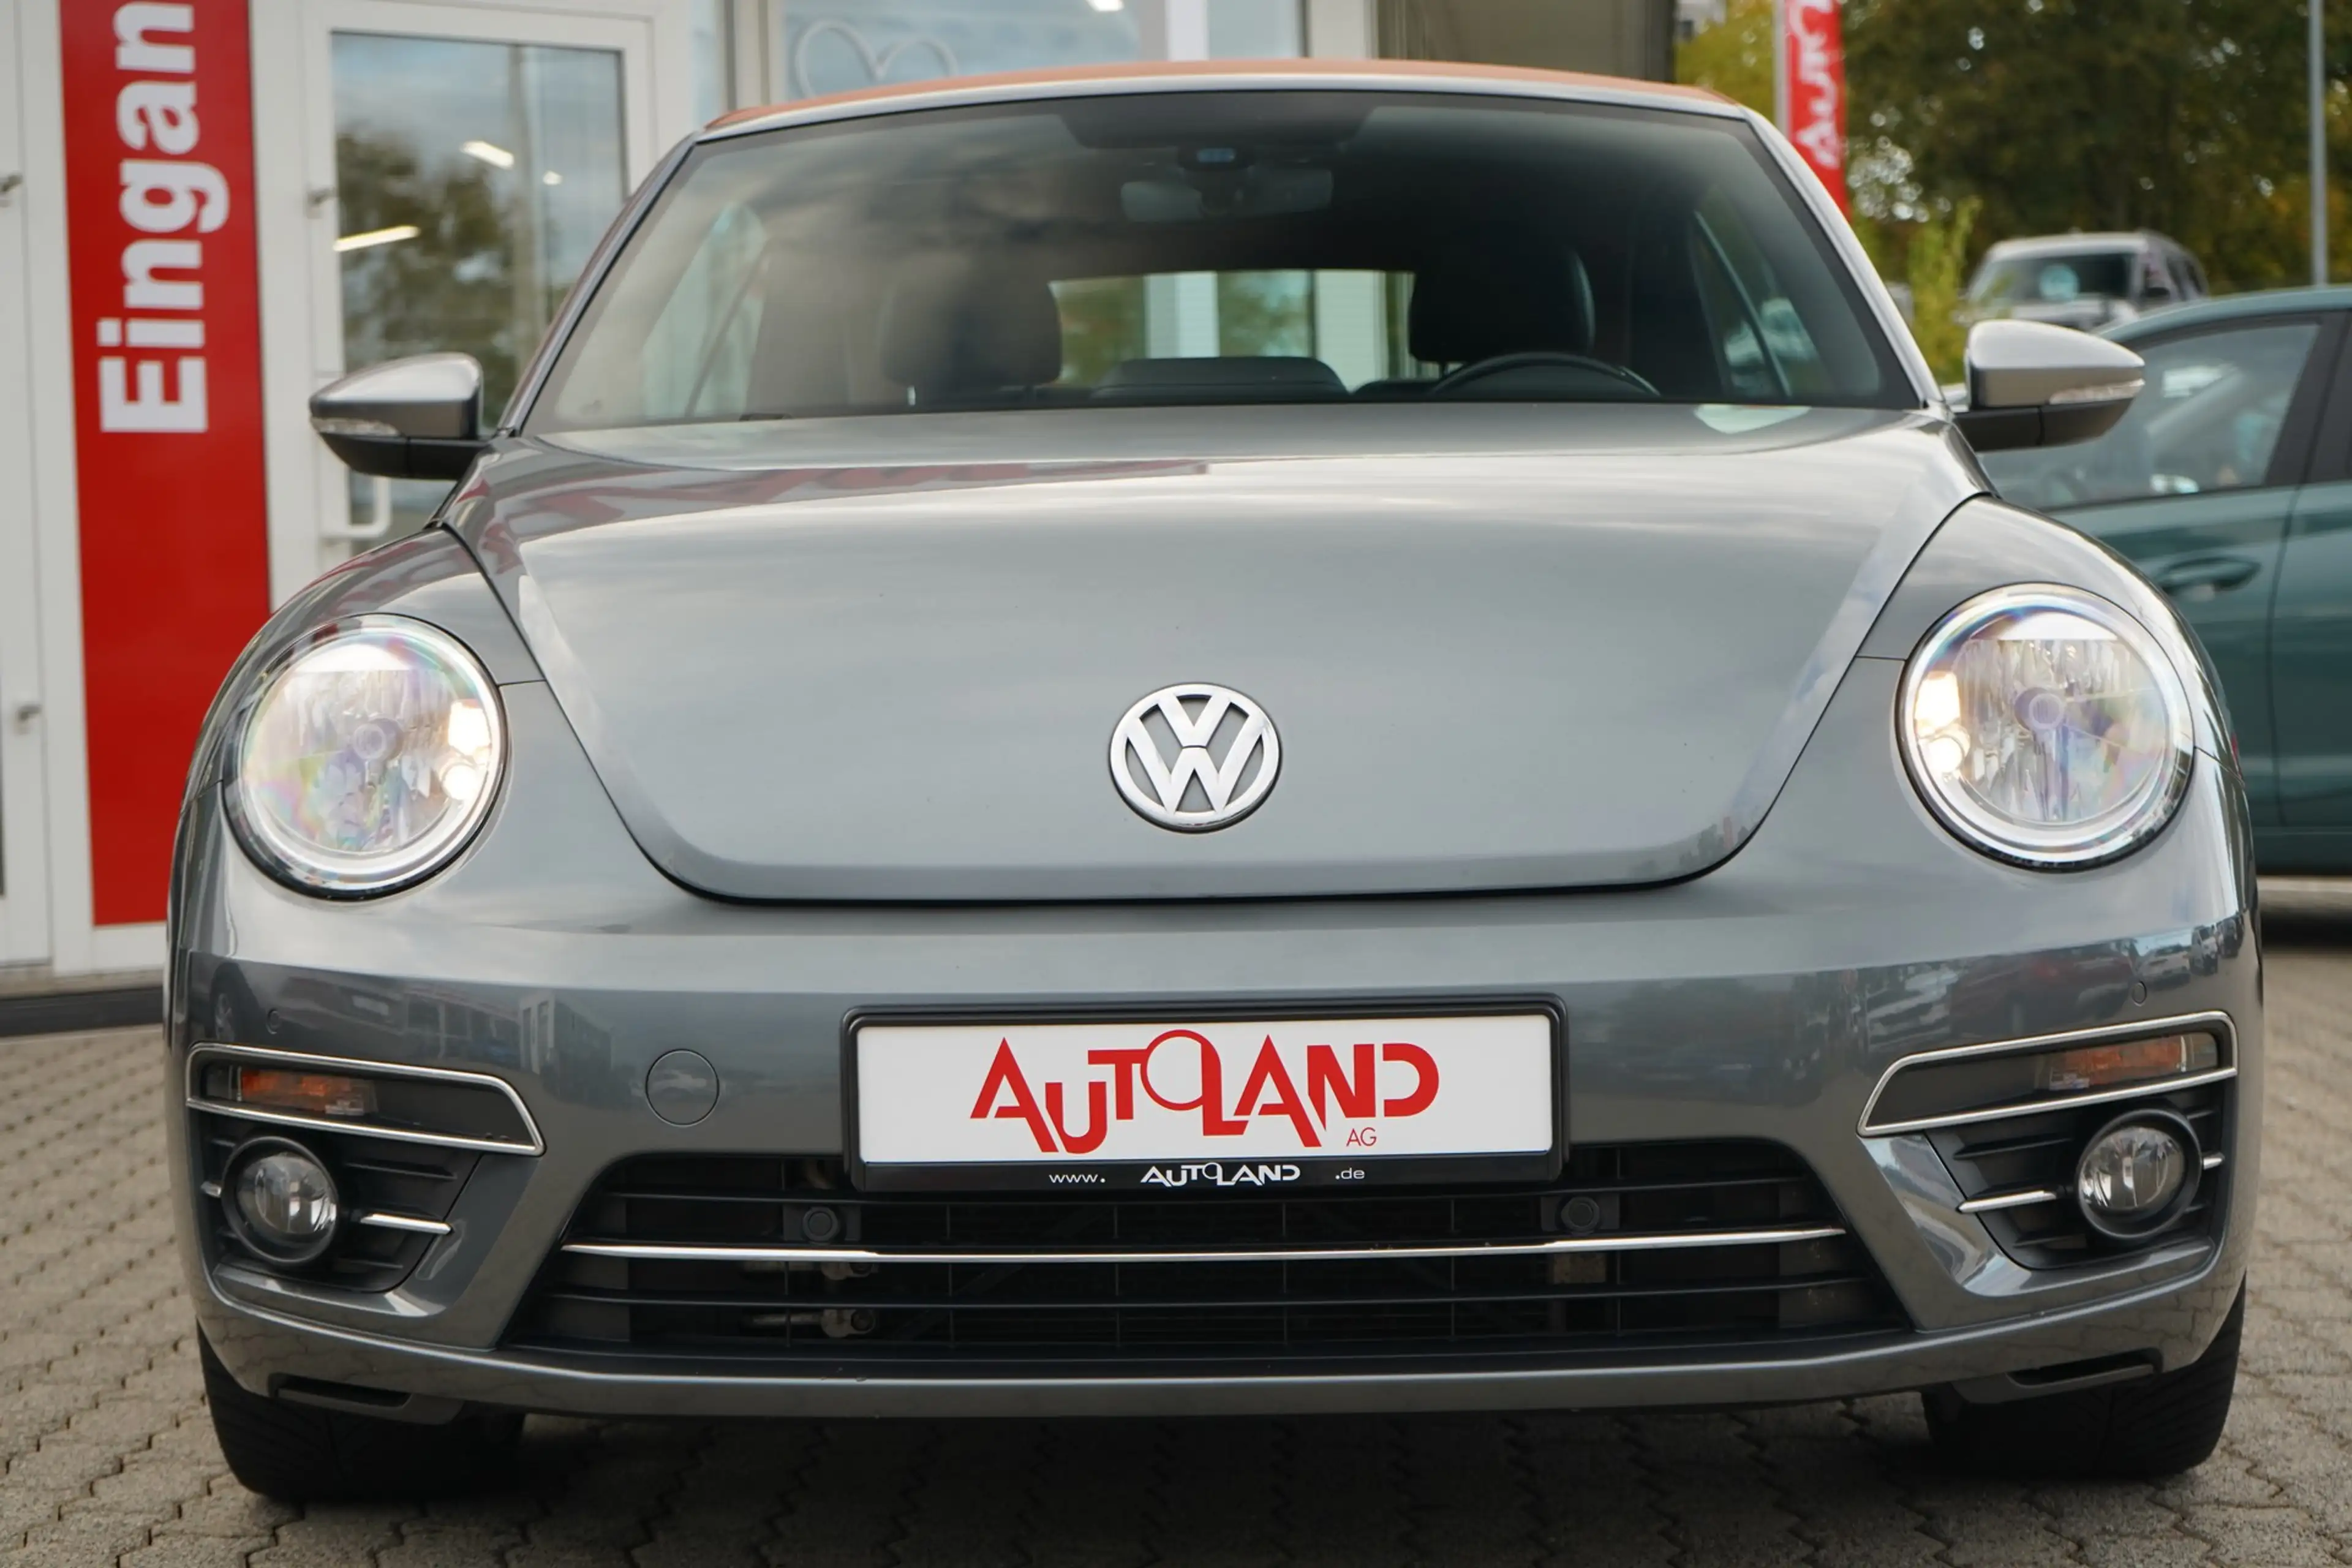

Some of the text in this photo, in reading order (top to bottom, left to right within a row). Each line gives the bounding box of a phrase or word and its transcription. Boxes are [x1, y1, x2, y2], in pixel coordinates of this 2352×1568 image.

[97, 1, 229, 433] Eingan
[1109, 682, 1280, 827] VW
[970, 1028, 1439, 1155] AUTOLAND
[1346, 1128, 1377, 1147] AG
[1049, 1161, 1365, 1187] www. AUTOLAND .de
